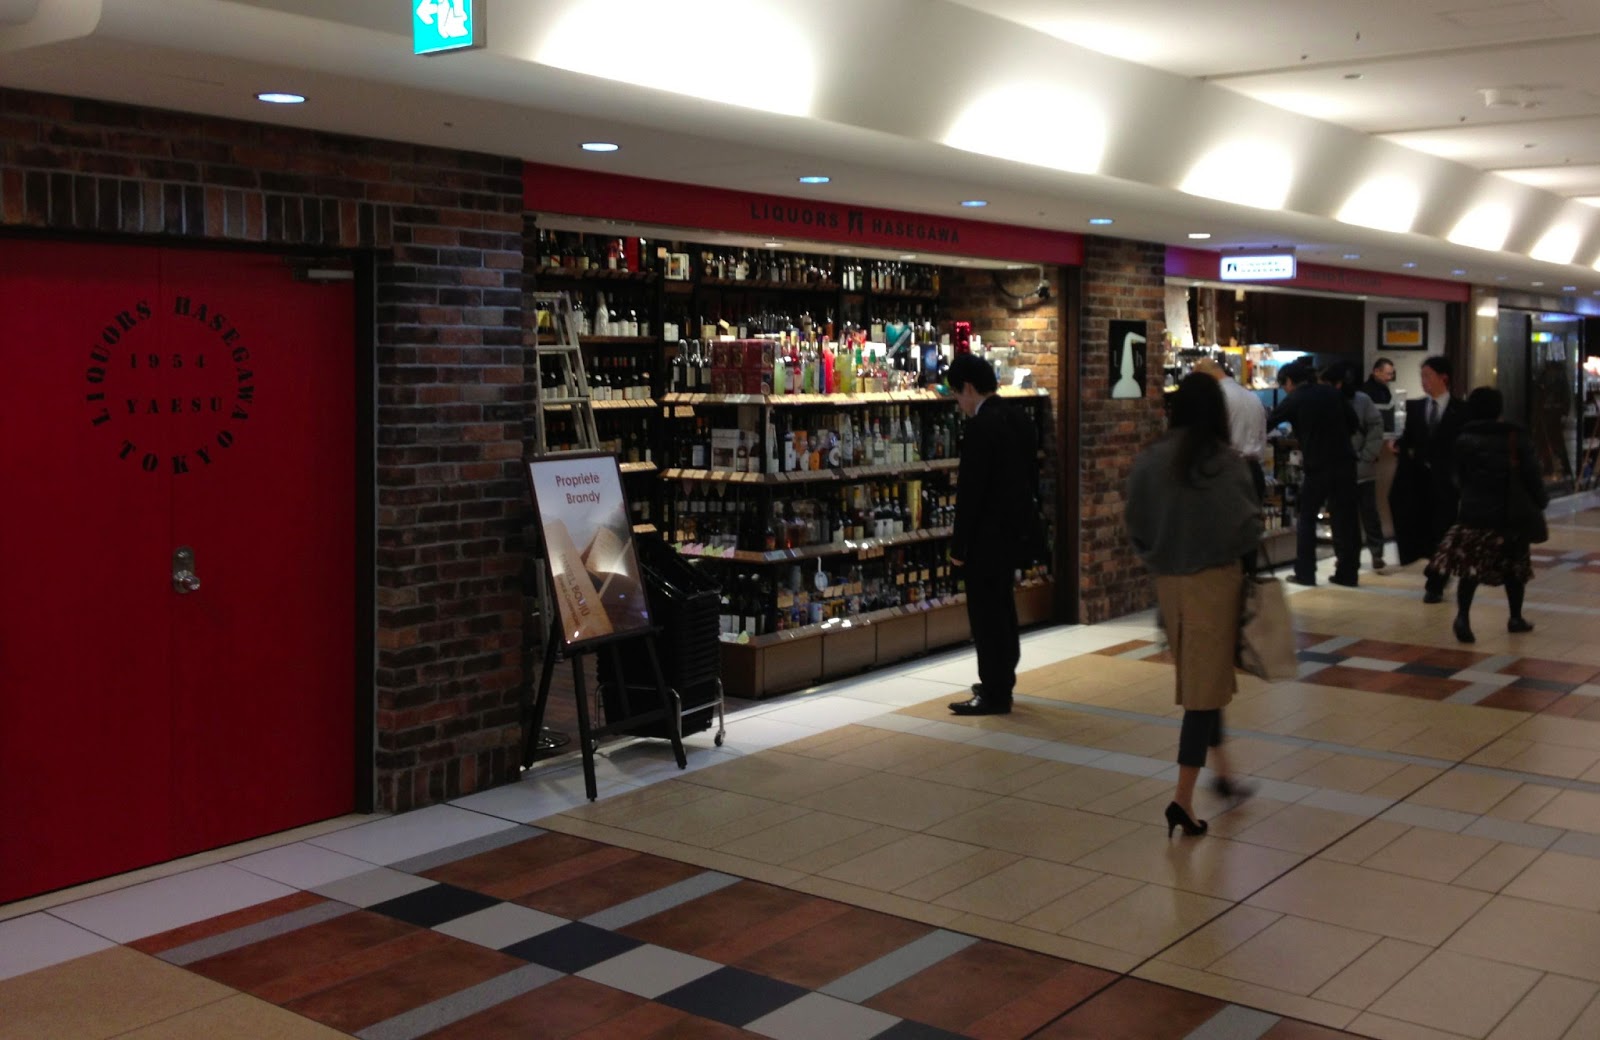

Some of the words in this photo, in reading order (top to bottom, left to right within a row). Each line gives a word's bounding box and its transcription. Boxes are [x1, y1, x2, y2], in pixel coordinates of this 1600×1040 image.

[751, 203, 839, 228] LIQUORS
[872, 218, 960, 243] HASEGAWA
[86, 301, 151, 427] LIQUORS
[173, 296, 255, 420] HASEGAWA
[130, 353, 205, 369] 1954
[126, 397, 222, 414] YAESU
[118, 429, 234, 475] TOKYO
[555, 472, 600, 488] Propriete
[566, 490, 601, 504] Brandy
